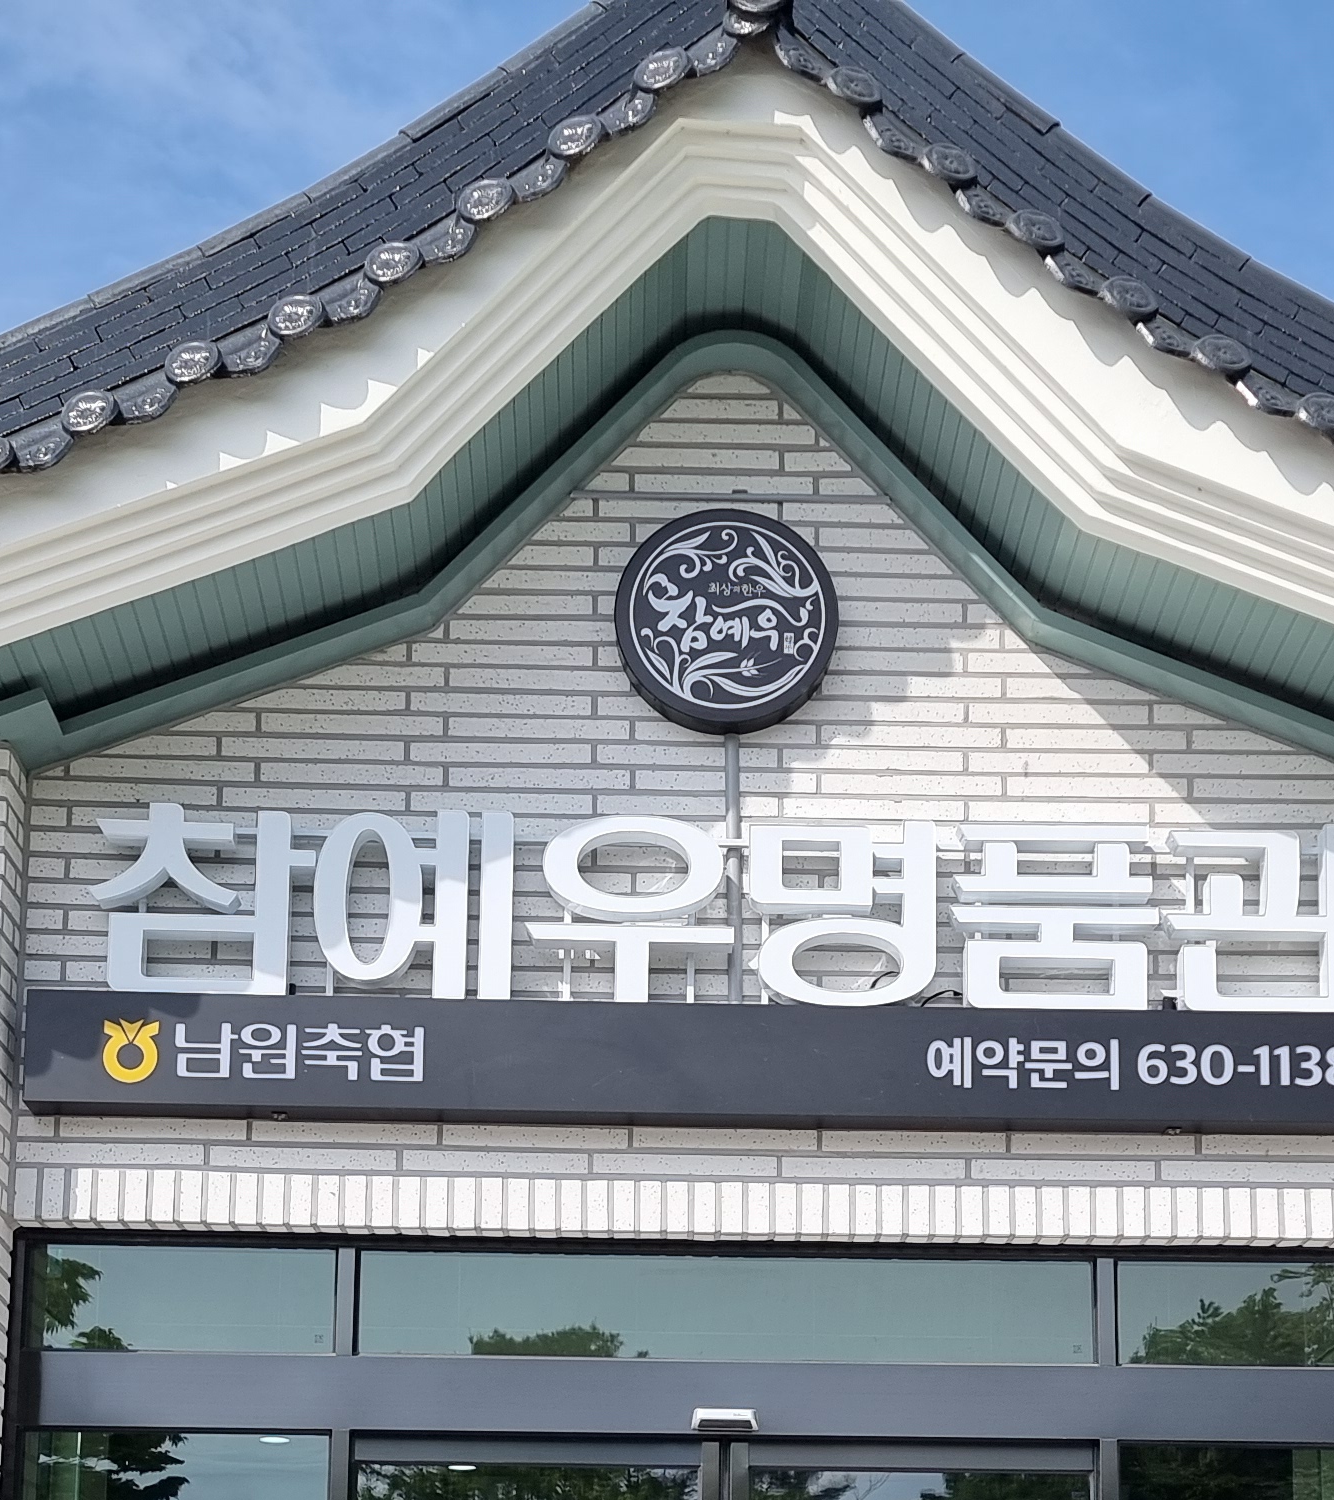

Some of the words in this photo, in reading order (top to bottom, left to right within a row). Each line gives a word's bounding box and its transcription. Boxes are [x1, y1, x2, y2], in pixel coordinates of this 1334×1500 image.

[644, 573, 779, 653] 참예우
[174, 1021, 424, 1084] 남원축협
[927, 1036, 1122, 1091] 예약문의
